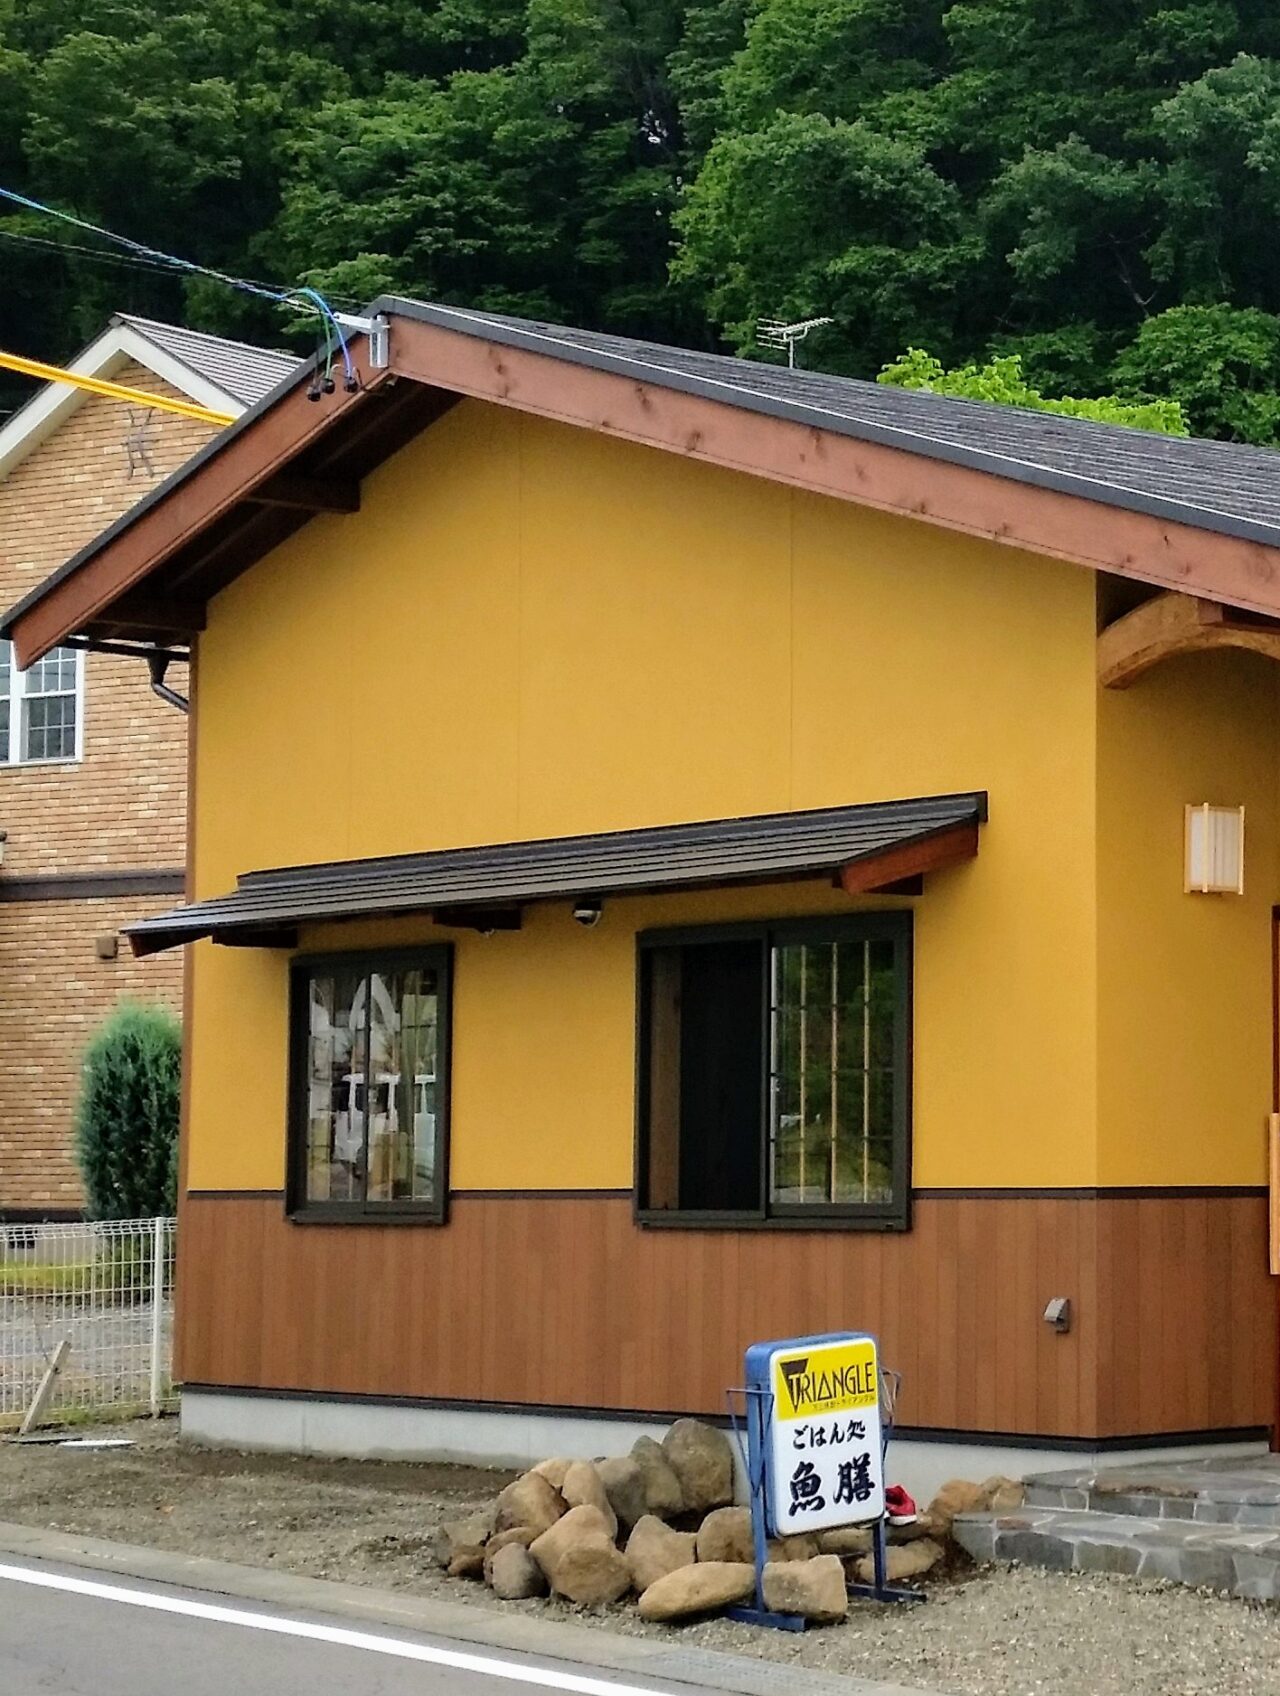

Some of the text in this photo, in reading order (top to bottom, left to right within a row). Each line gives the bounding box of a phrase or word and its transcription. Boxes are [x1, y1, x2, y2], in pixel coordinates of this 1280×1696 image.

[783, 1360, 875, 1408] TRIANGLE
[793, 1420, 866, 1450] ごはん処
